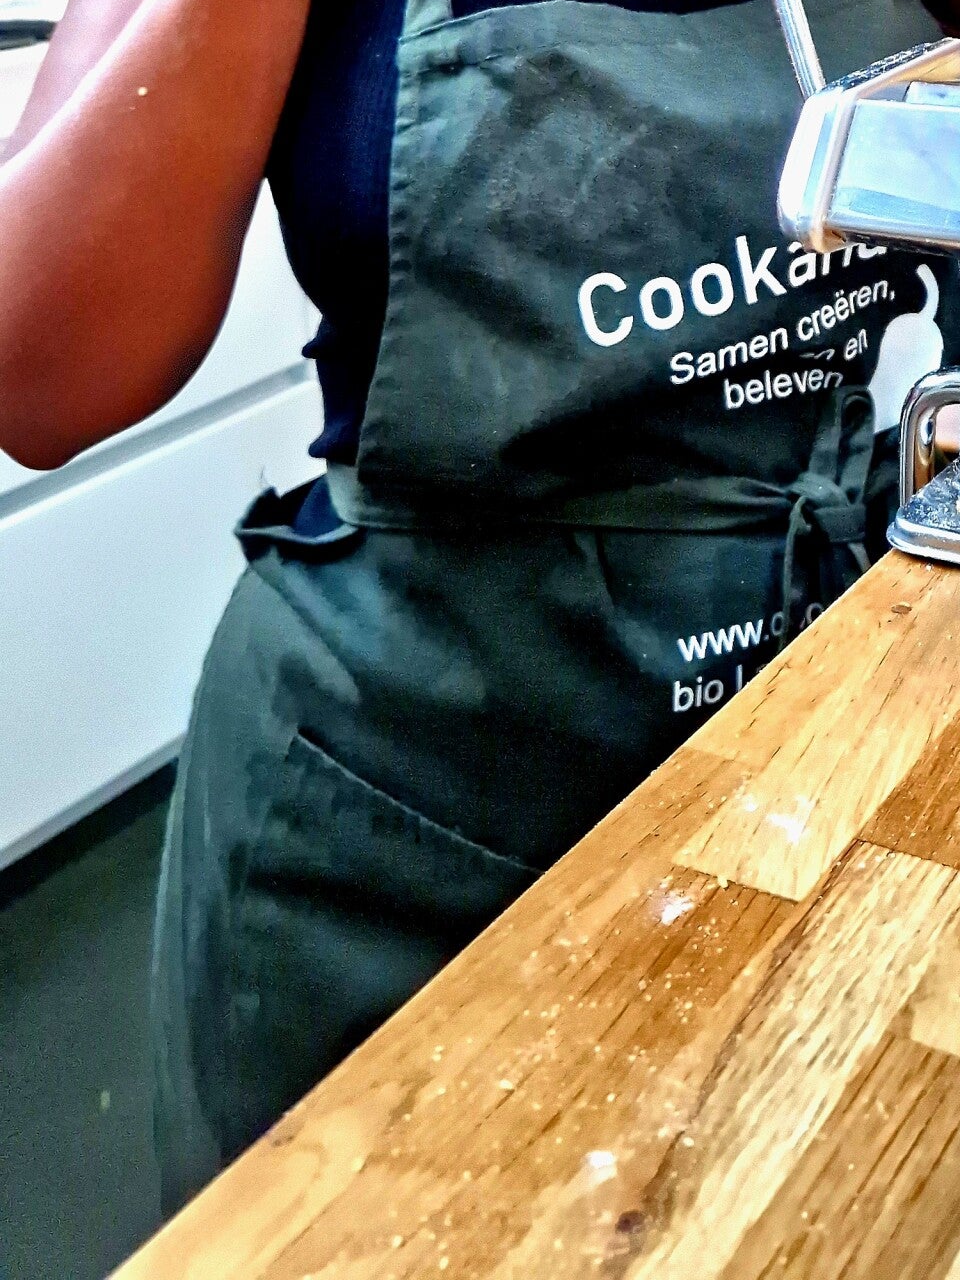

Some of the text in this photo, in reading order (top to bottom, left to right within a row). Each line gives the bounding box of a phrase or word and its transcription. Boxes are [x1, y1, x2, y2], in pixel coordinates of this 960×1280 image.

[669, 279, 896, 386] Samen creëren,
[844, 328, 868, 362] en
[723, 369, 844, 410] beleven
[672, 676, 724, 713] bio
